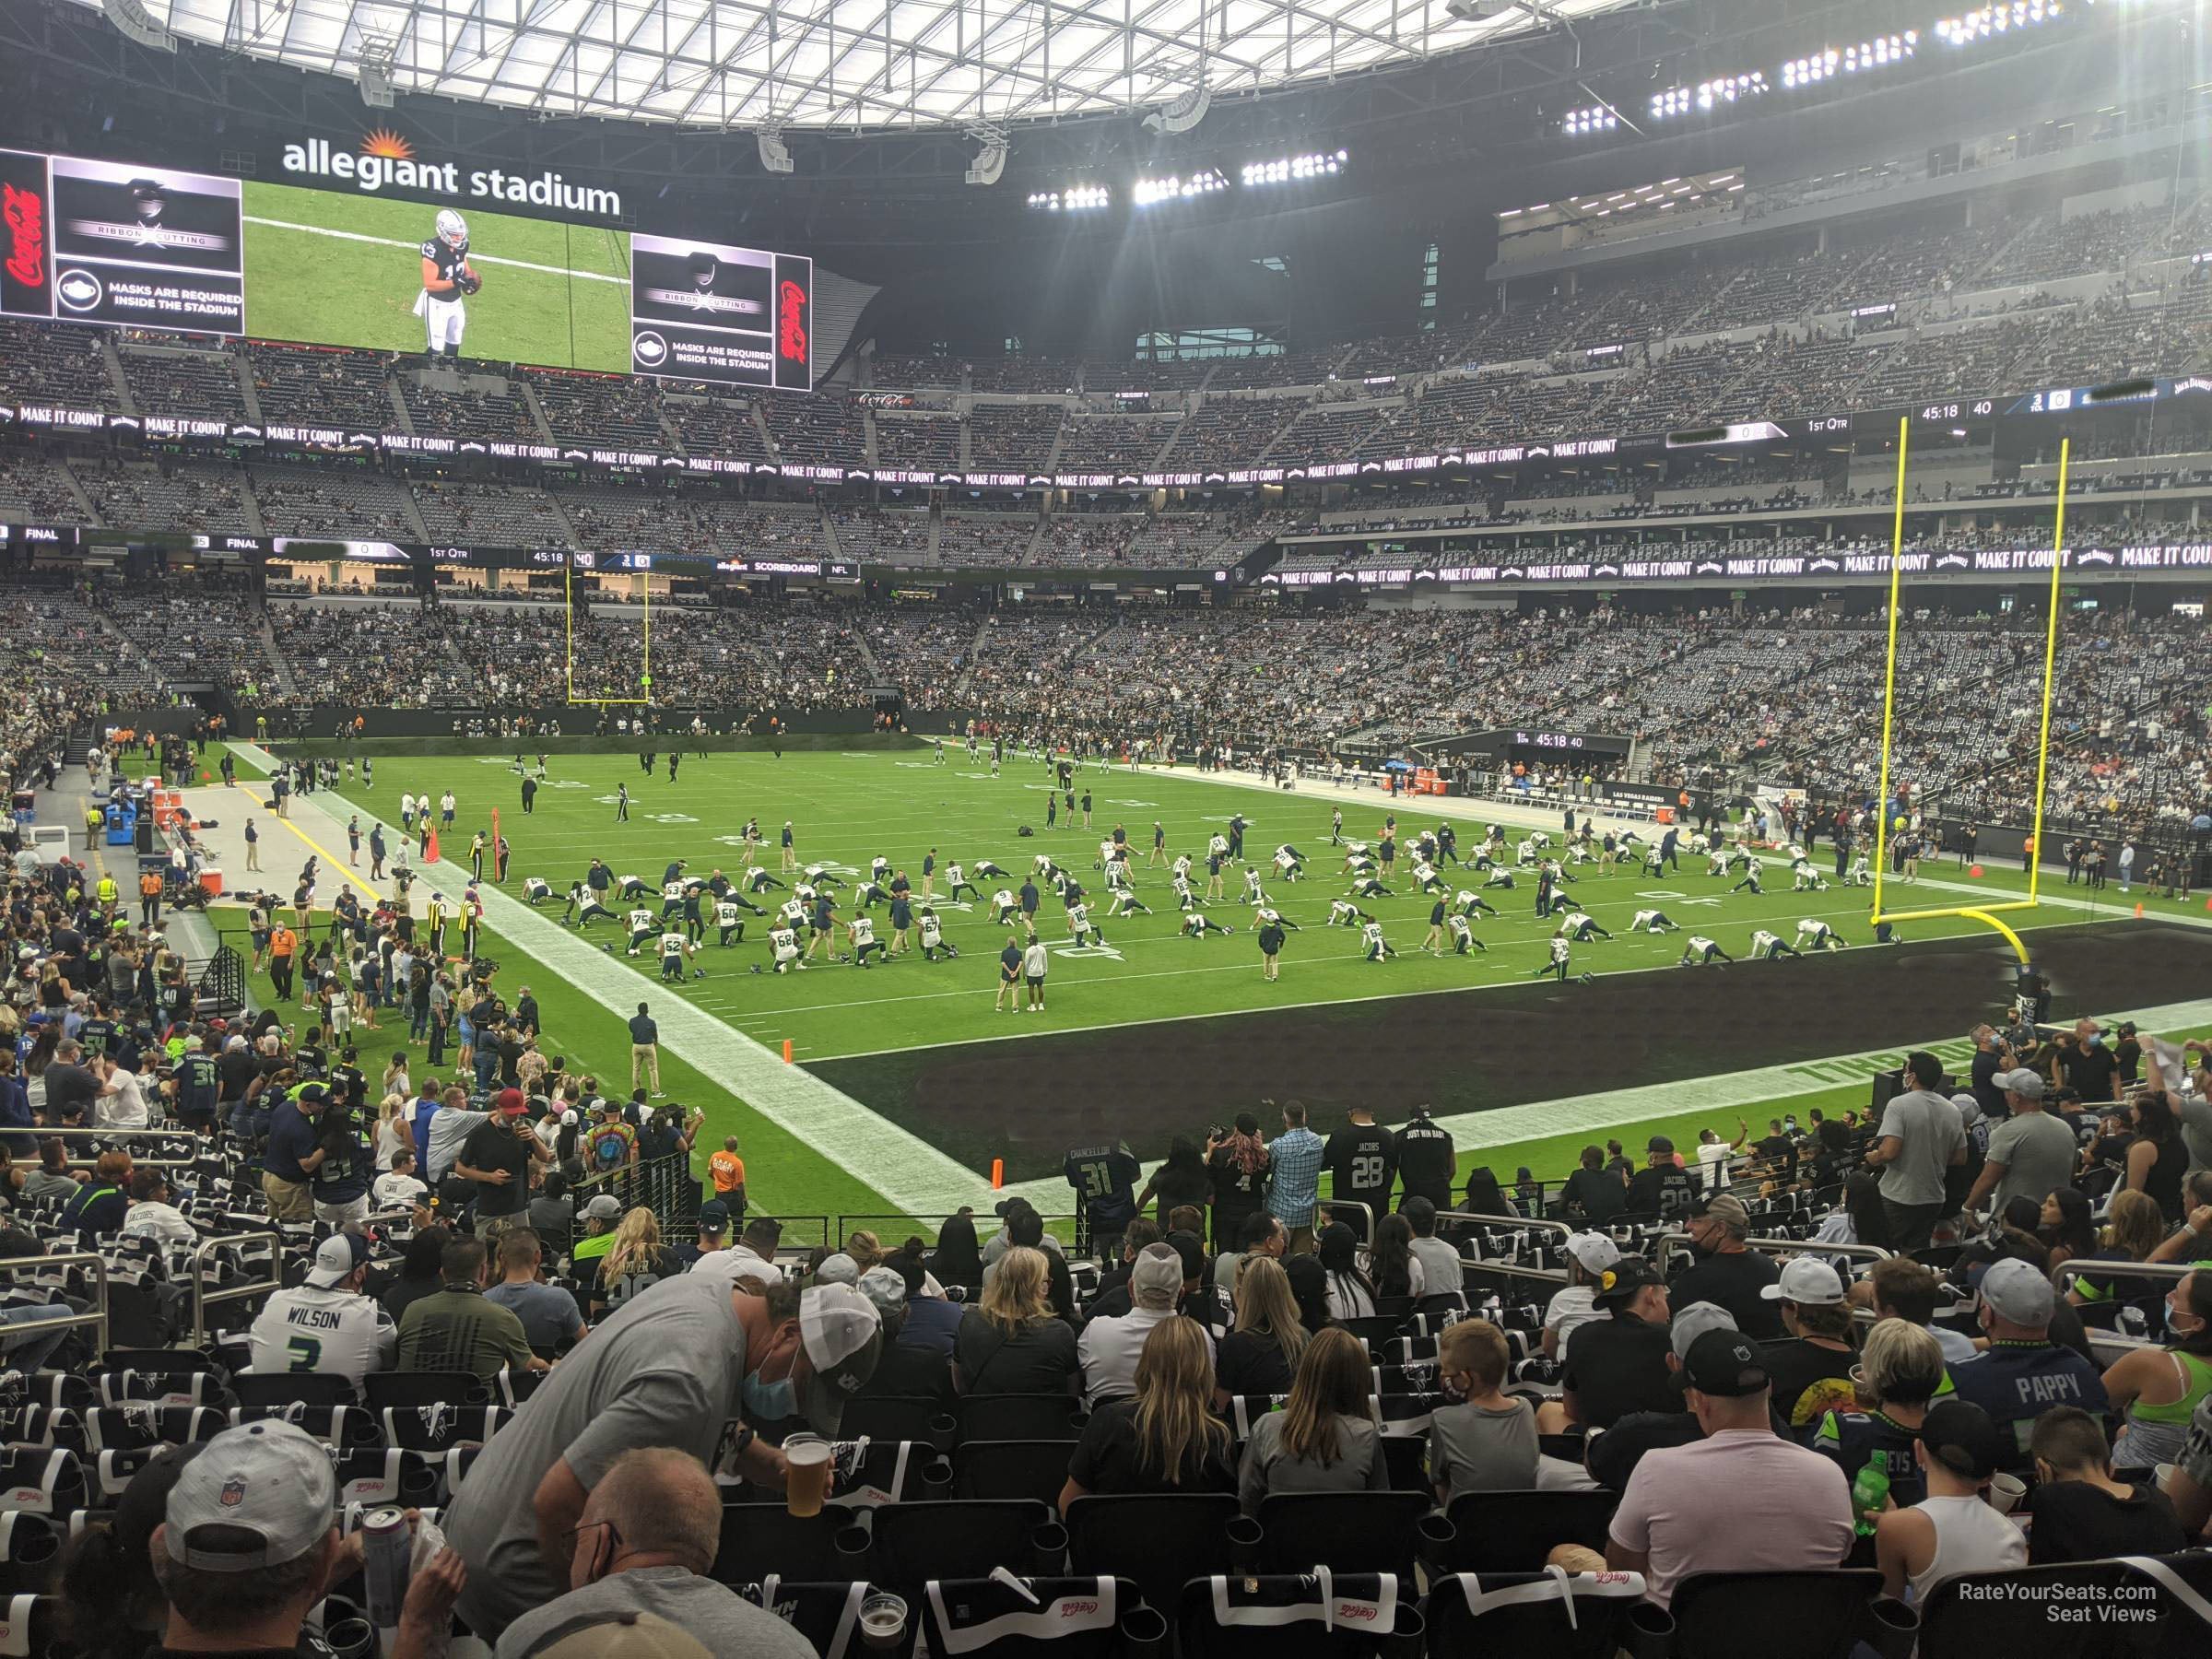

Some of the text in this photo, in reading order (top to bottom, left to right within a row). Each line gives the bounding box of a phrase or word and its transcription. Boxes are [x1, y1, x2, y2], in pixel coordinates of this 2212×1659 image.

[283, 137, 620, 215] allegiant stadium
[4, 182, 44, 288] Coca-Cola
[98, 225, 206, 246] RIBBON CUTTING
[110, 282, 242, 303] MASKS ARE REQUIRED
[114, 295, 238, 316] INSIDE THE STADIUM
[665, 293, 746, 309] RIBBON CUTTING
[781, 280, 806, 365] Coca-Cola
[672, 342, 772, 360] MASKS ARE REQUIRED
[677, 353, 769, 370] INSIDE THE STADIUM
[2033, 394, 2042, 404] 3
[2055, 394, 2065, 406] 0
[1923, 405, 1959, 419] 45:18
[1973, 401, 1992, 414] 40
[21, 407, 52, 422] MAKE
[55, 410, 66, 423] IT
[68, 412, 104, 426] COUNT
[146, 418, 227, 435] MAKE IT COUNT
[1808, 418, 1847, 431] 1ST QTR
[267, 427, 345, 443] MAKE IT COUNT
[1741, 427, 1749, 438] 0
[382, 435, 408, 448] MAKE
[412, 438, 421, 449] IT
[423, 439, 454, 451] COUNT
[1554, 443, 1576, 456] MAKE
[1579, 441, 1587, 455] IT
[1588, 439, 1617, 453] COUNT
[594, 451, 617, 464] MAKE
[619, 453, 628, 464] IT
[629, 454, 658, 465] COUNT
[1385, 459, 1404, 471] MAKE
[1406, 459, 1413, 470] IT
[1414, 455, 1438, 468] COUNT
[966, 474, 988, 485] MAKE
[990, 475, 998, 485] IT
[997, 475, 1025, 485] COUNT
[26, 529, 58, 540] FINAL
[227, 538, 259, 549] FINAL
[361, 544, 369, 555] 0
[429, 547, 467, 559] 1ST QTR
[534, 552, 563, 562] 45:18
[576, 552, 593, 565] 40
[1976, 552, 2009, 568] MAKE
[2013, 551, 2025, 567] IT
[2122, 547, 2160, 565] MAKE
[2164, 547, 2179, 564] IT
[717, 561, 818, 573] allegiant SCOREBOARD
[831, 565, 848, 574] NFL
[1623, 563, 1648, 576] MAKE
[1650, 563, 1660, 576] IT
[1661, 562, 1692, 575] COUNT
[1728, 559, 1805, 574] MAKE IT COUNT
[1845, 554, 1930, 571] MAKE IT OUNT
[1440, 569, 1460, 580] MAKE
[1462, 568, 1470, 580] IT
[1471, 567, 1497, 580] COUNT
[1536, 734, 1567, 747] 45:18
[1571, 737, 1583, 747] 40
[1641, 794, 1665, 803] RAIDERS
[634, 914, 649, 924] 75
[723, 909, 735, 919] 60
[1076, 911, 1086, 923] 10
[925, 921, 937, 932] 67
[163, 989, 177, 1004] 40
[21, 1041, 33, 1051] 12
[84, 1035, 107, 1055] 54
[193, 1063, 215, 1087] 31
[1406, 1128, 1445, 1140] JUST WIN BABY
[1357, 1142, 1380, 1153] JACOBS
[1351, 1156, 1384, 1189] 28
[1080, 1163, 1113, 1197] 31
[1664, 1175, 1687, 1185] JACOBS
[128, 1209, 156, 1222] JACOBS
[287, 1306, 341, 1330] WILSON
[2016, 1372, 2083, 1404] PAPPY
[223, 1491, 242, 1505] NFL
[1595, 1571, 1630, 1585] Coca-Cola
[1062, 1602, 1098, 1618] Coca-Cola
[1338, 1605, 1378, 1621] Coca-Cola
